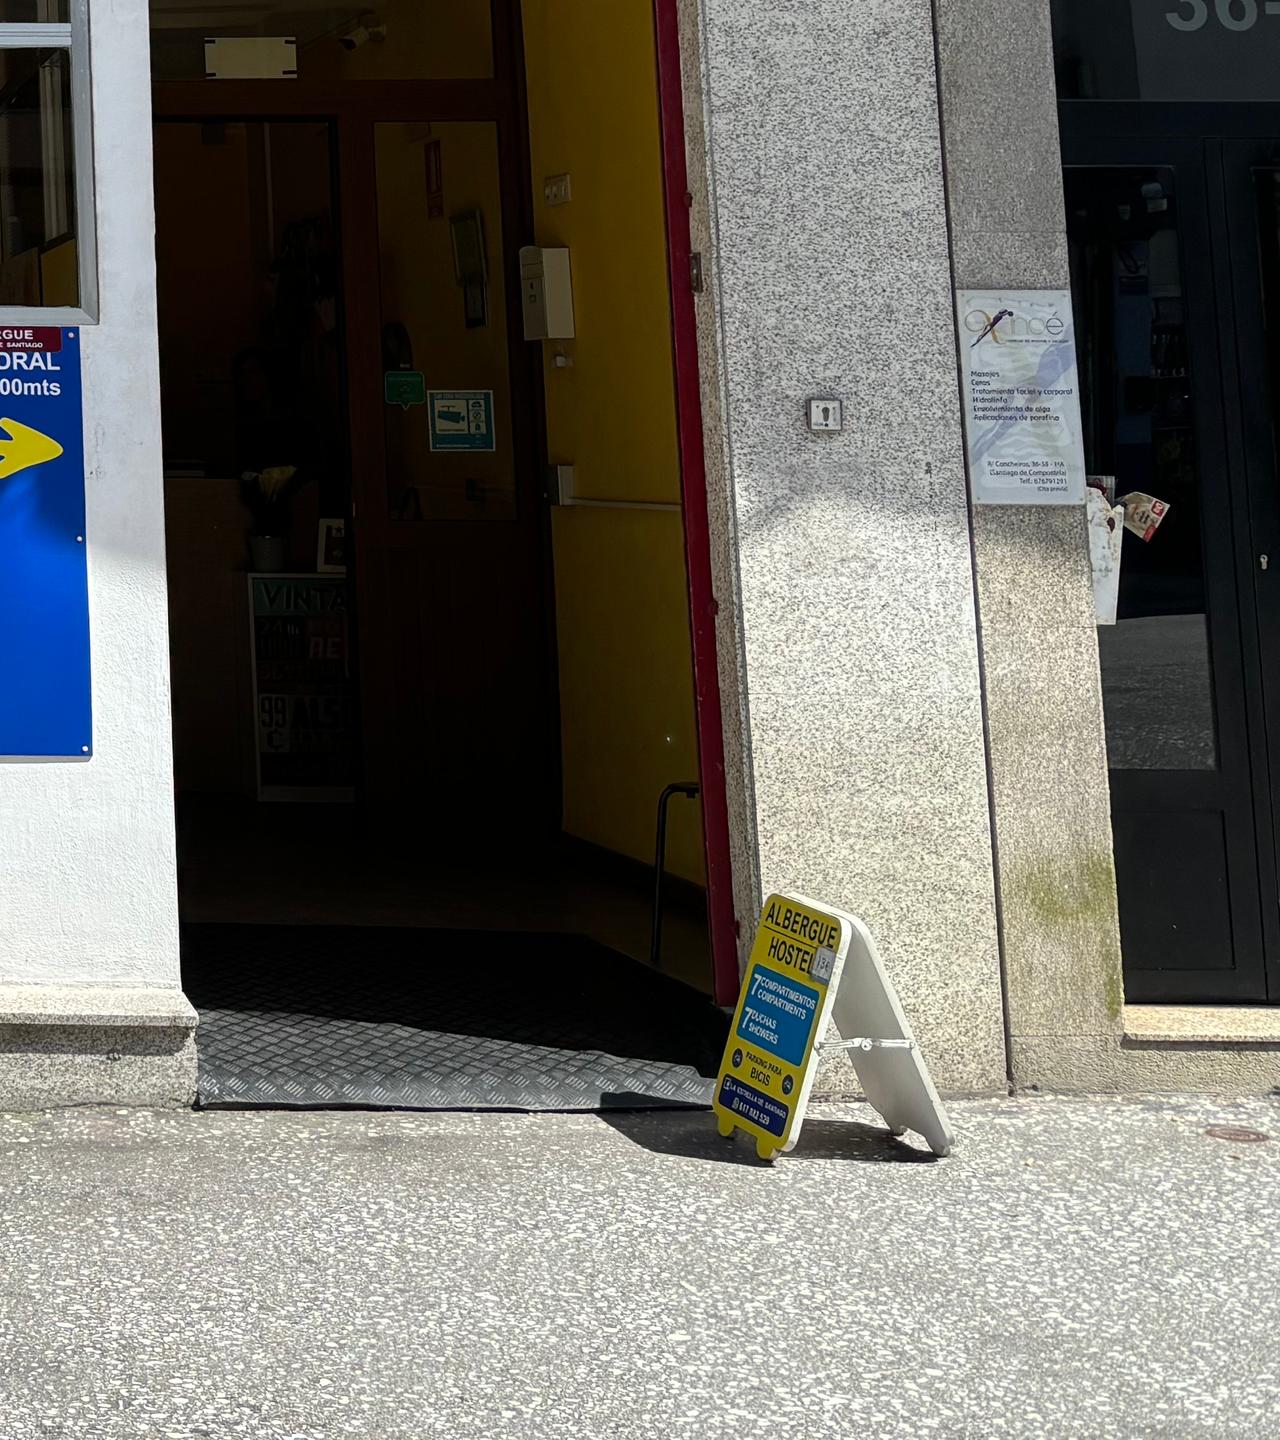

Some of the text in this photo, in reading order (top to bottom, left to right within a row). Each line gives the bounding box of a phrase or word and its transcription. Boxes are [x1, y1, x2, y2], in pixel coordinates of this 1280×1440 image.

[765, 902, 838, 950] ALBERGUE
[751, 973, 762, 996] 7
[742, 1007, 753, 1029] 7
